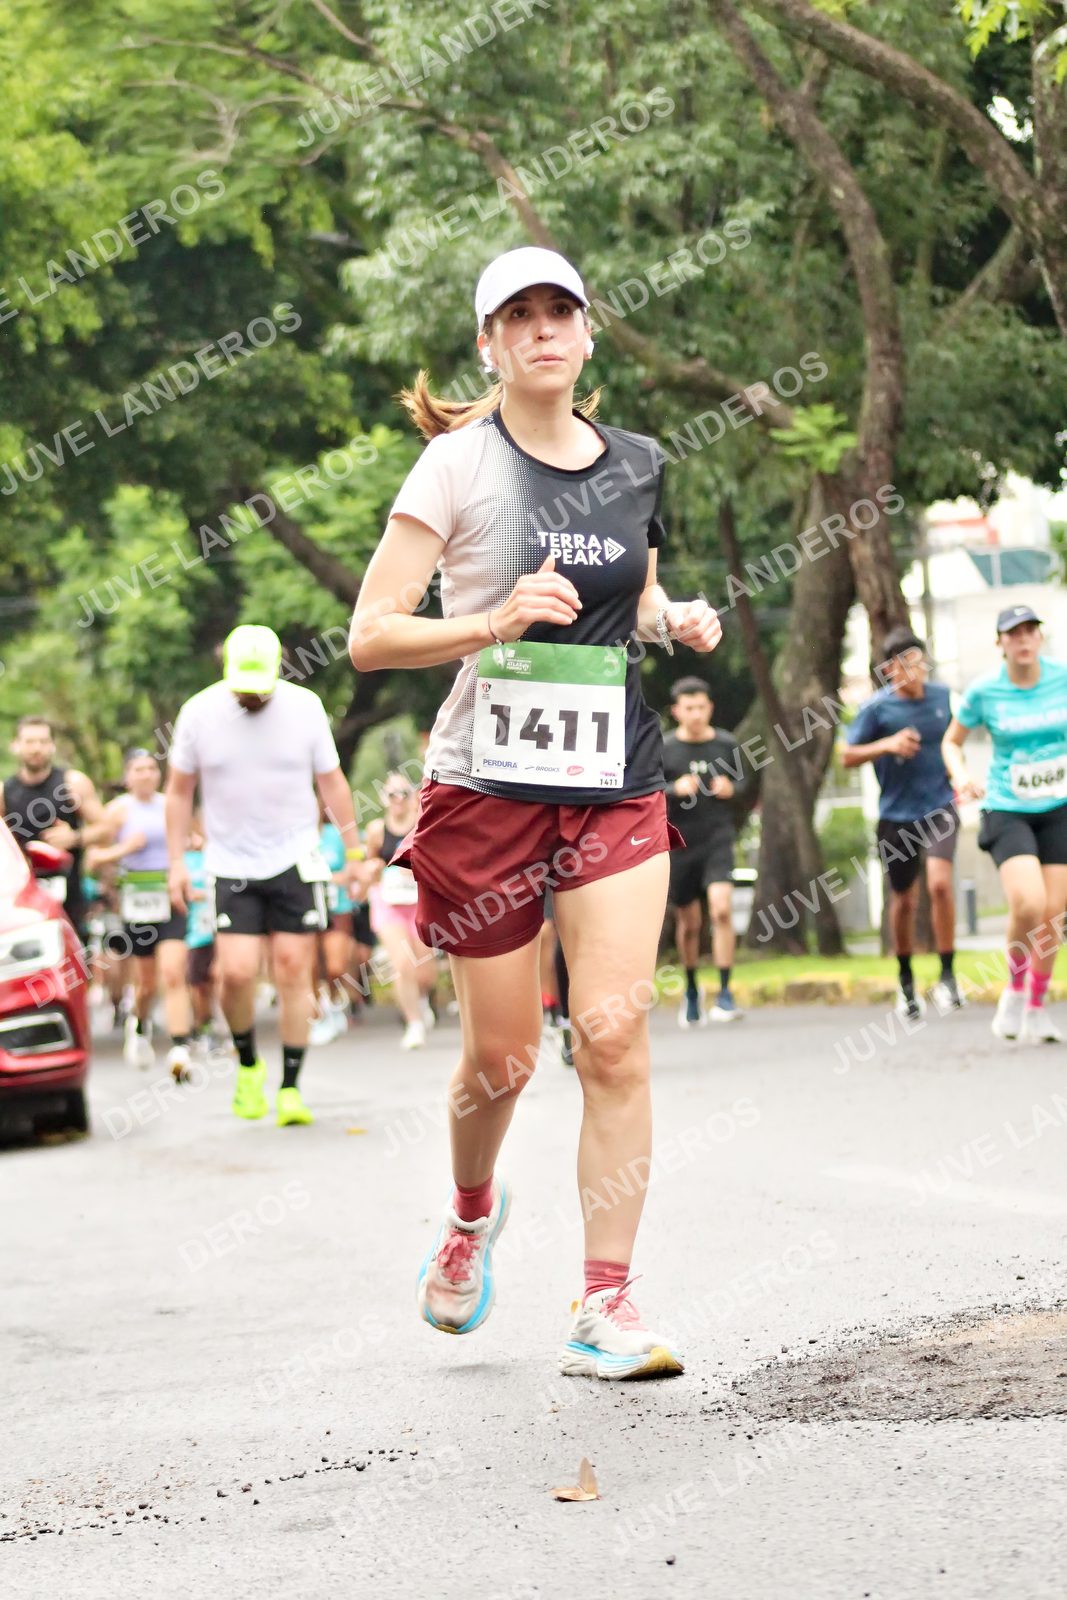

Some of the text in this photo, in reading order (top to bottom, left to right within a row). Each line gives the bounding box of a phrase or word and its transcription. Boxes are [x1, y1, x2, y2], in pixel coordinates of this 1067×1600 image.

[537, 531, 602, 550] TERRA
[550, 547, 603, 566] PEAK
[491, 704, 610, 753] 1411
[483, 759, 517, 769] PERDURA
